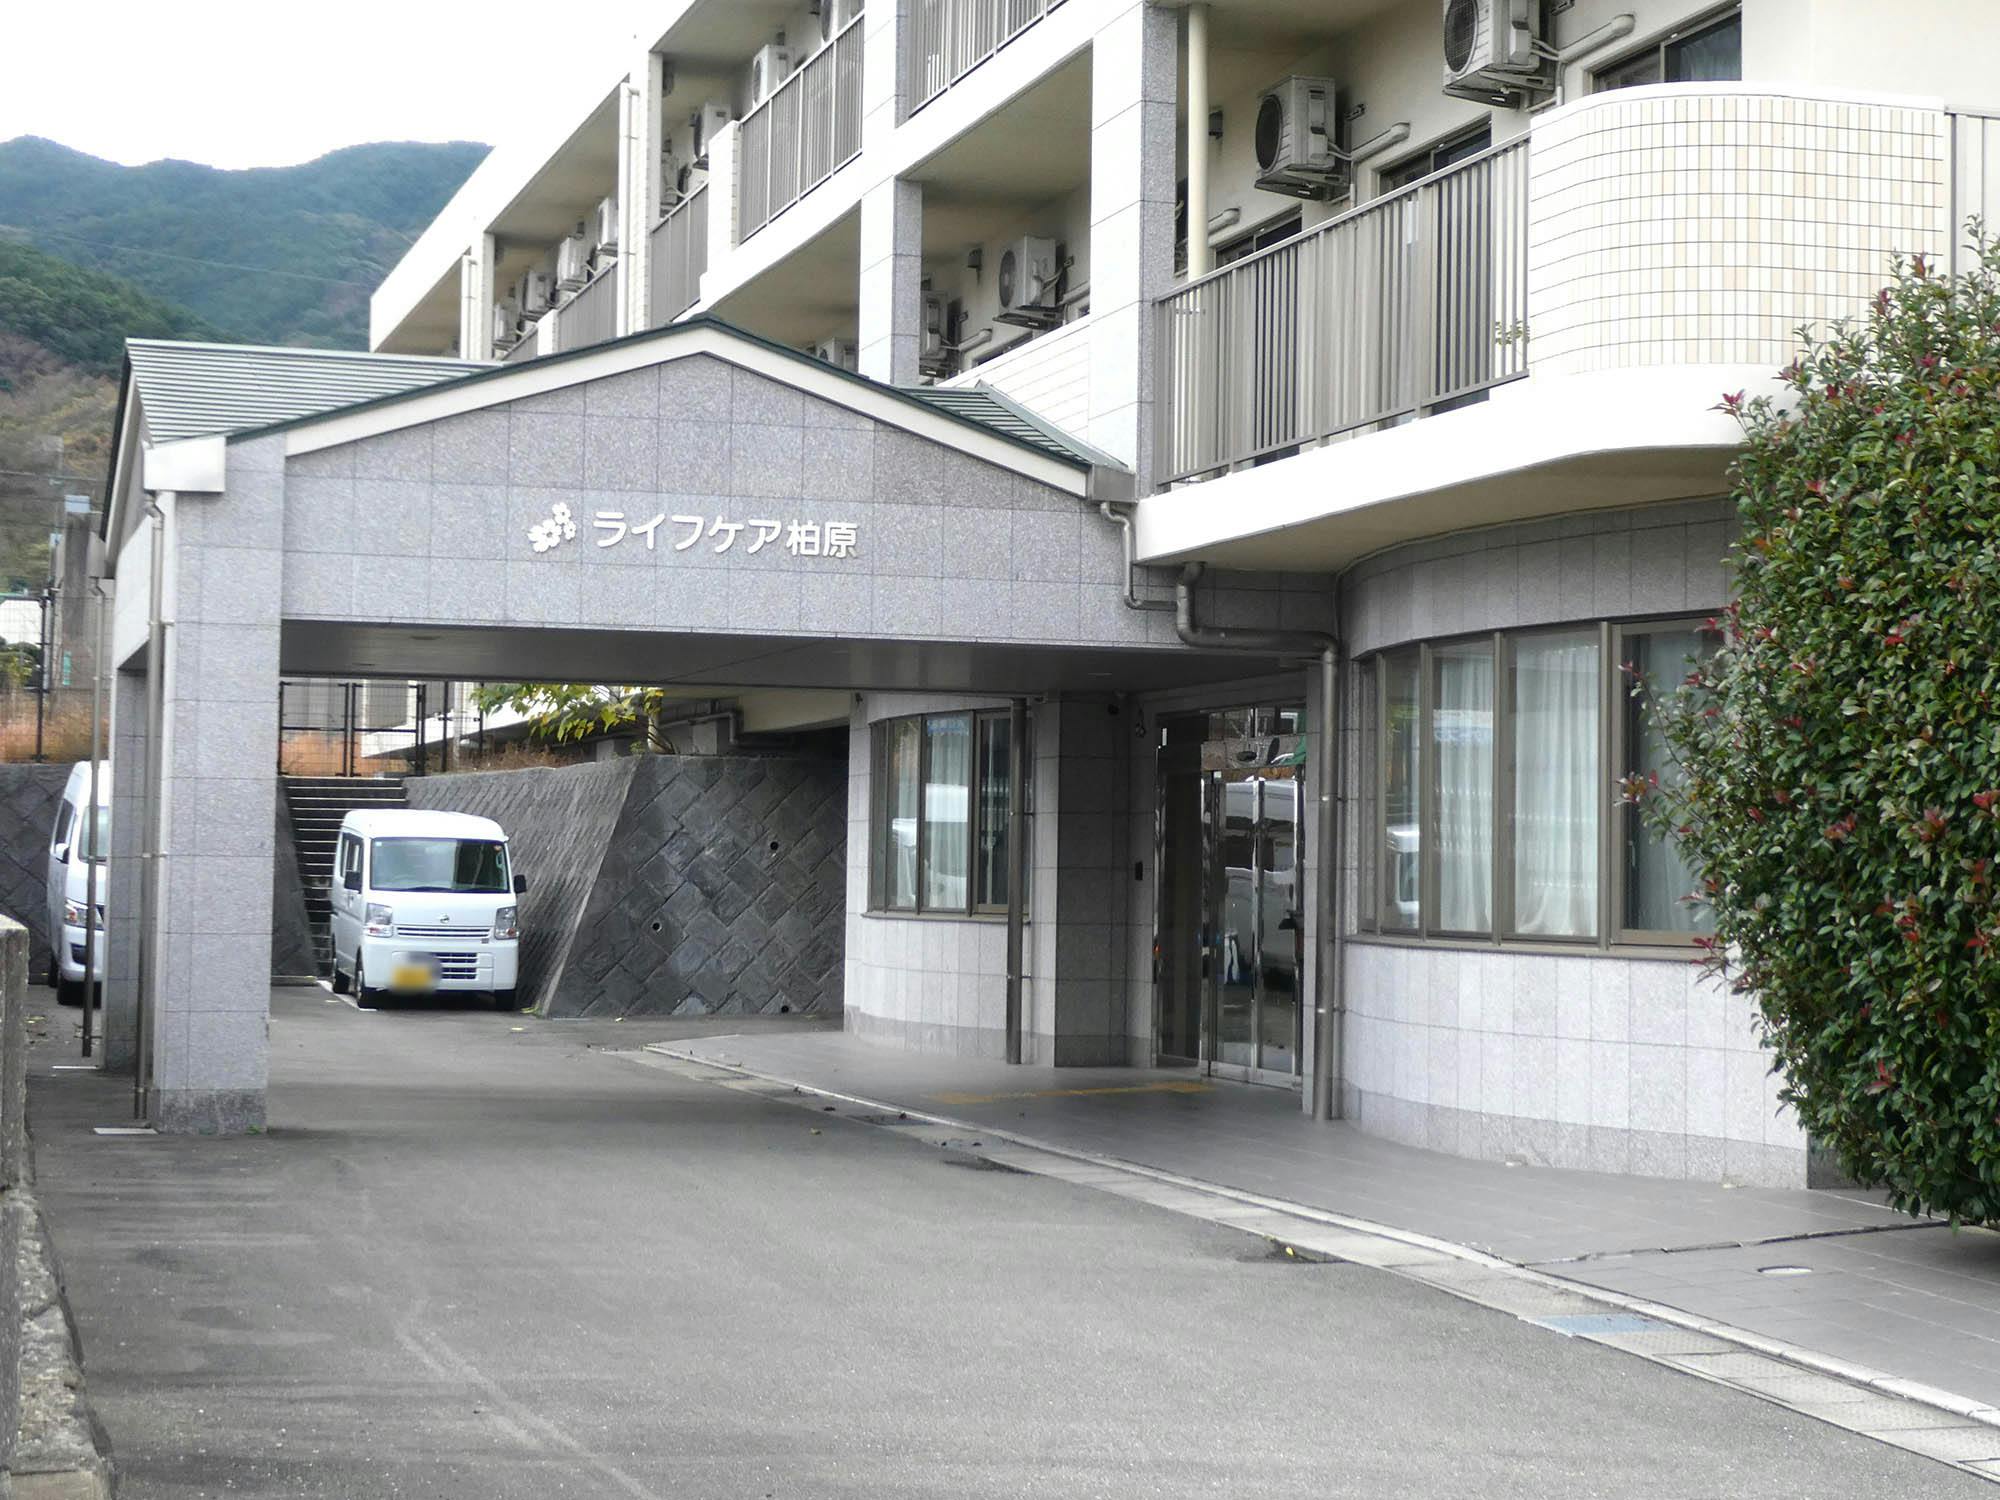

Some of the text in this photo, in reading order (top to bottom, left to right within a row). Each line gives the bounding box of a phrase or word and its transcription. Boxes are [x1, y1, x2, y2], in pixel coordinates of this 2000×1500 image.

[593, 511, 858, 558] ライフケア柏原
